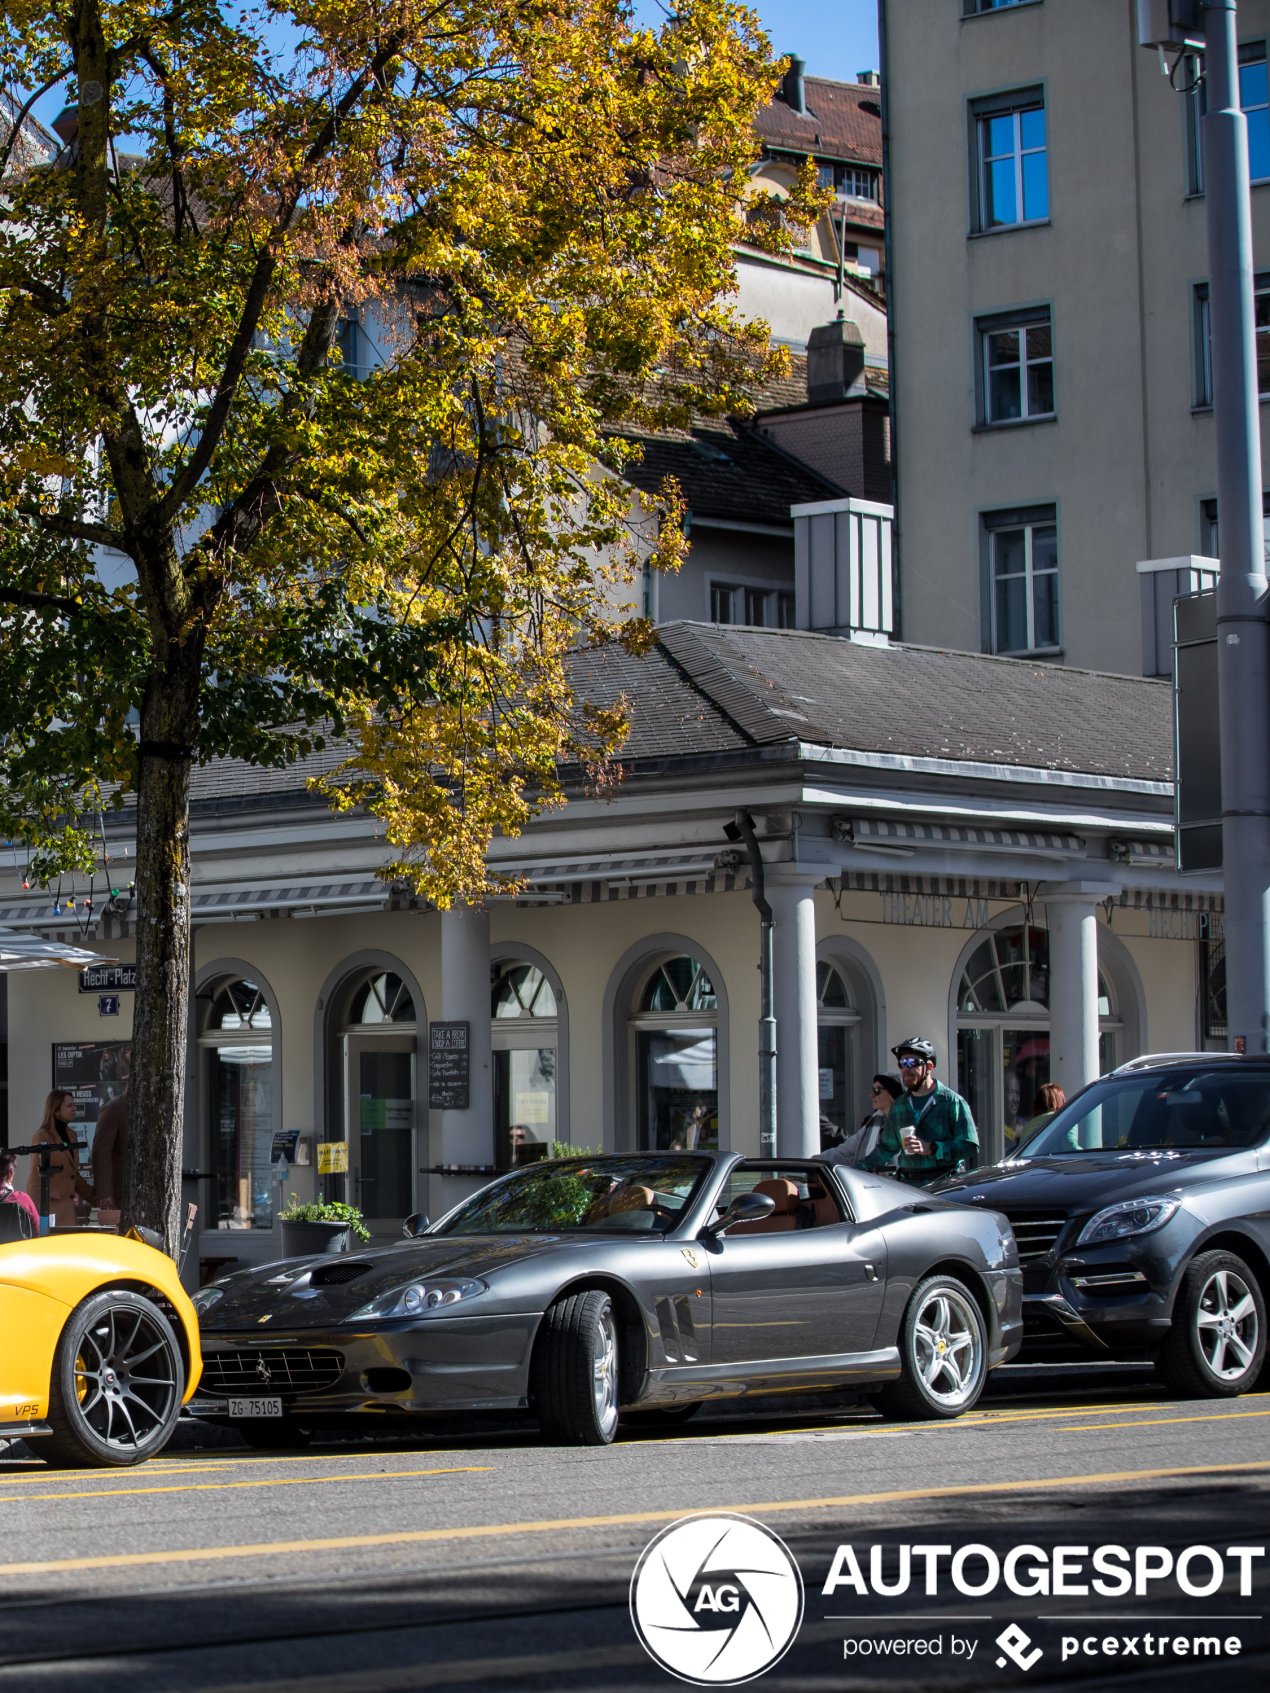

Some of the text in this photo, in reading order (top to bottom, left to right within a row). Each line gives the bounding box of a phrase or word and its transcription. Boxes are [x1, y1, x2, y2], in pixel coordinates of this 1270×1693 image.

[880, 891, 989, 928] THEATER AM
[1150, 909, 1226, 939] HECHTPLA
[105, 998, 112, 1013] 7
[433, 1030, 445, 1039] TAKE
[57, 1051, 67, 1059] LES
[15, 1404, 39, 1416] VPS
